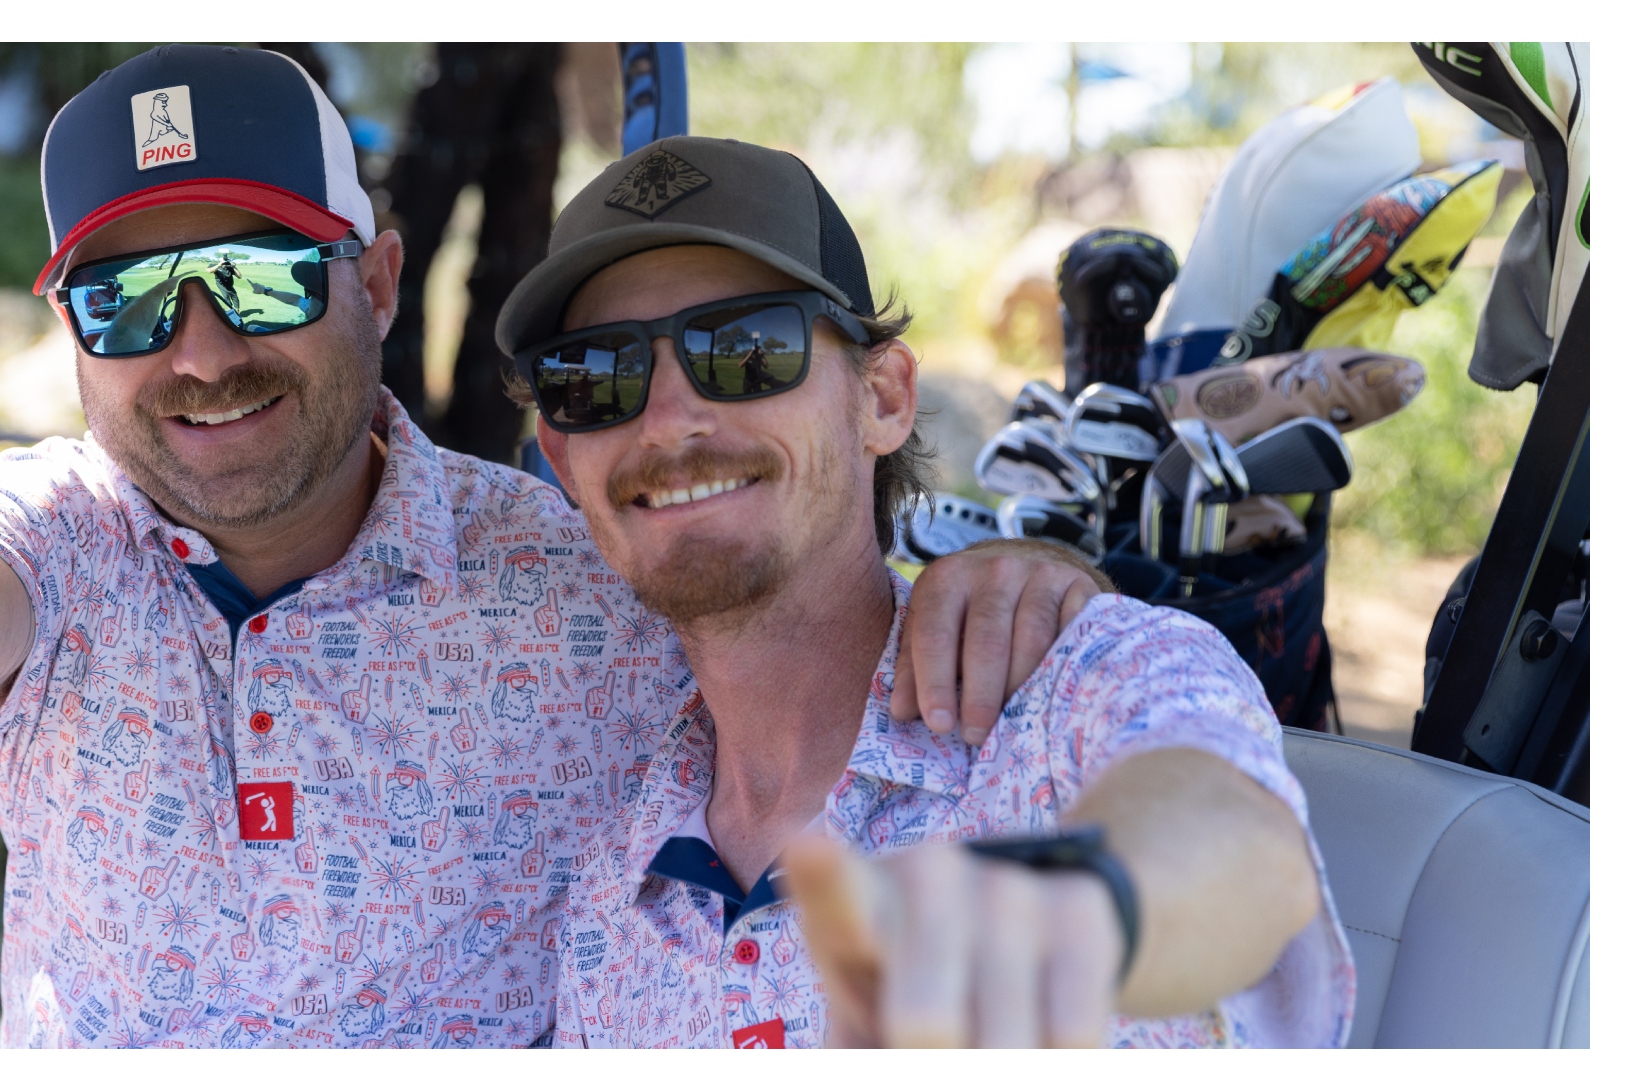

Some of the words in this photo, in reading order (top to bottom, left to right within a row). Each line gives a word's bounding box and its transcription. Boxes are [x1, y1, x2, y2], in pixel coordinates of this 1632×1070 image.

[141, 142, 191, 166] PING
[494, 535, 512, 544] FREE
[587, 573, 604, 584] FREE
[570, 615, 604, 626] FOOTBALL
[322, 622, 357, 631] FOOTBALL
[161, 637, 177, 648] FREE
[434, 642, 473, 662] USA
[369, 661, 386, 671] FREE
[388, 661, 398, 671] AS
[614, 658, 631, 667] FREE
[632, 658, 641, 667] AS
[295, 700, 311, 709] FREE
[540, 704, 556, 714] FREE
[254, 768, 270, 777] FREE
[313, 757, 353, 781] USA
[551, 756, 592, 786] USA
[343, 815, 360, 826] FREE
[324, 854, 359, 868] FOOTBALL
[572, 843, 600, 871] USA
[429, 886, 465, 905] USA
[365, 903, 383, 913] FREE
[95, 918, 128, 945] USA
[291, 994, 327, 1016] USA
[495, 986, 533, 1013] USA
